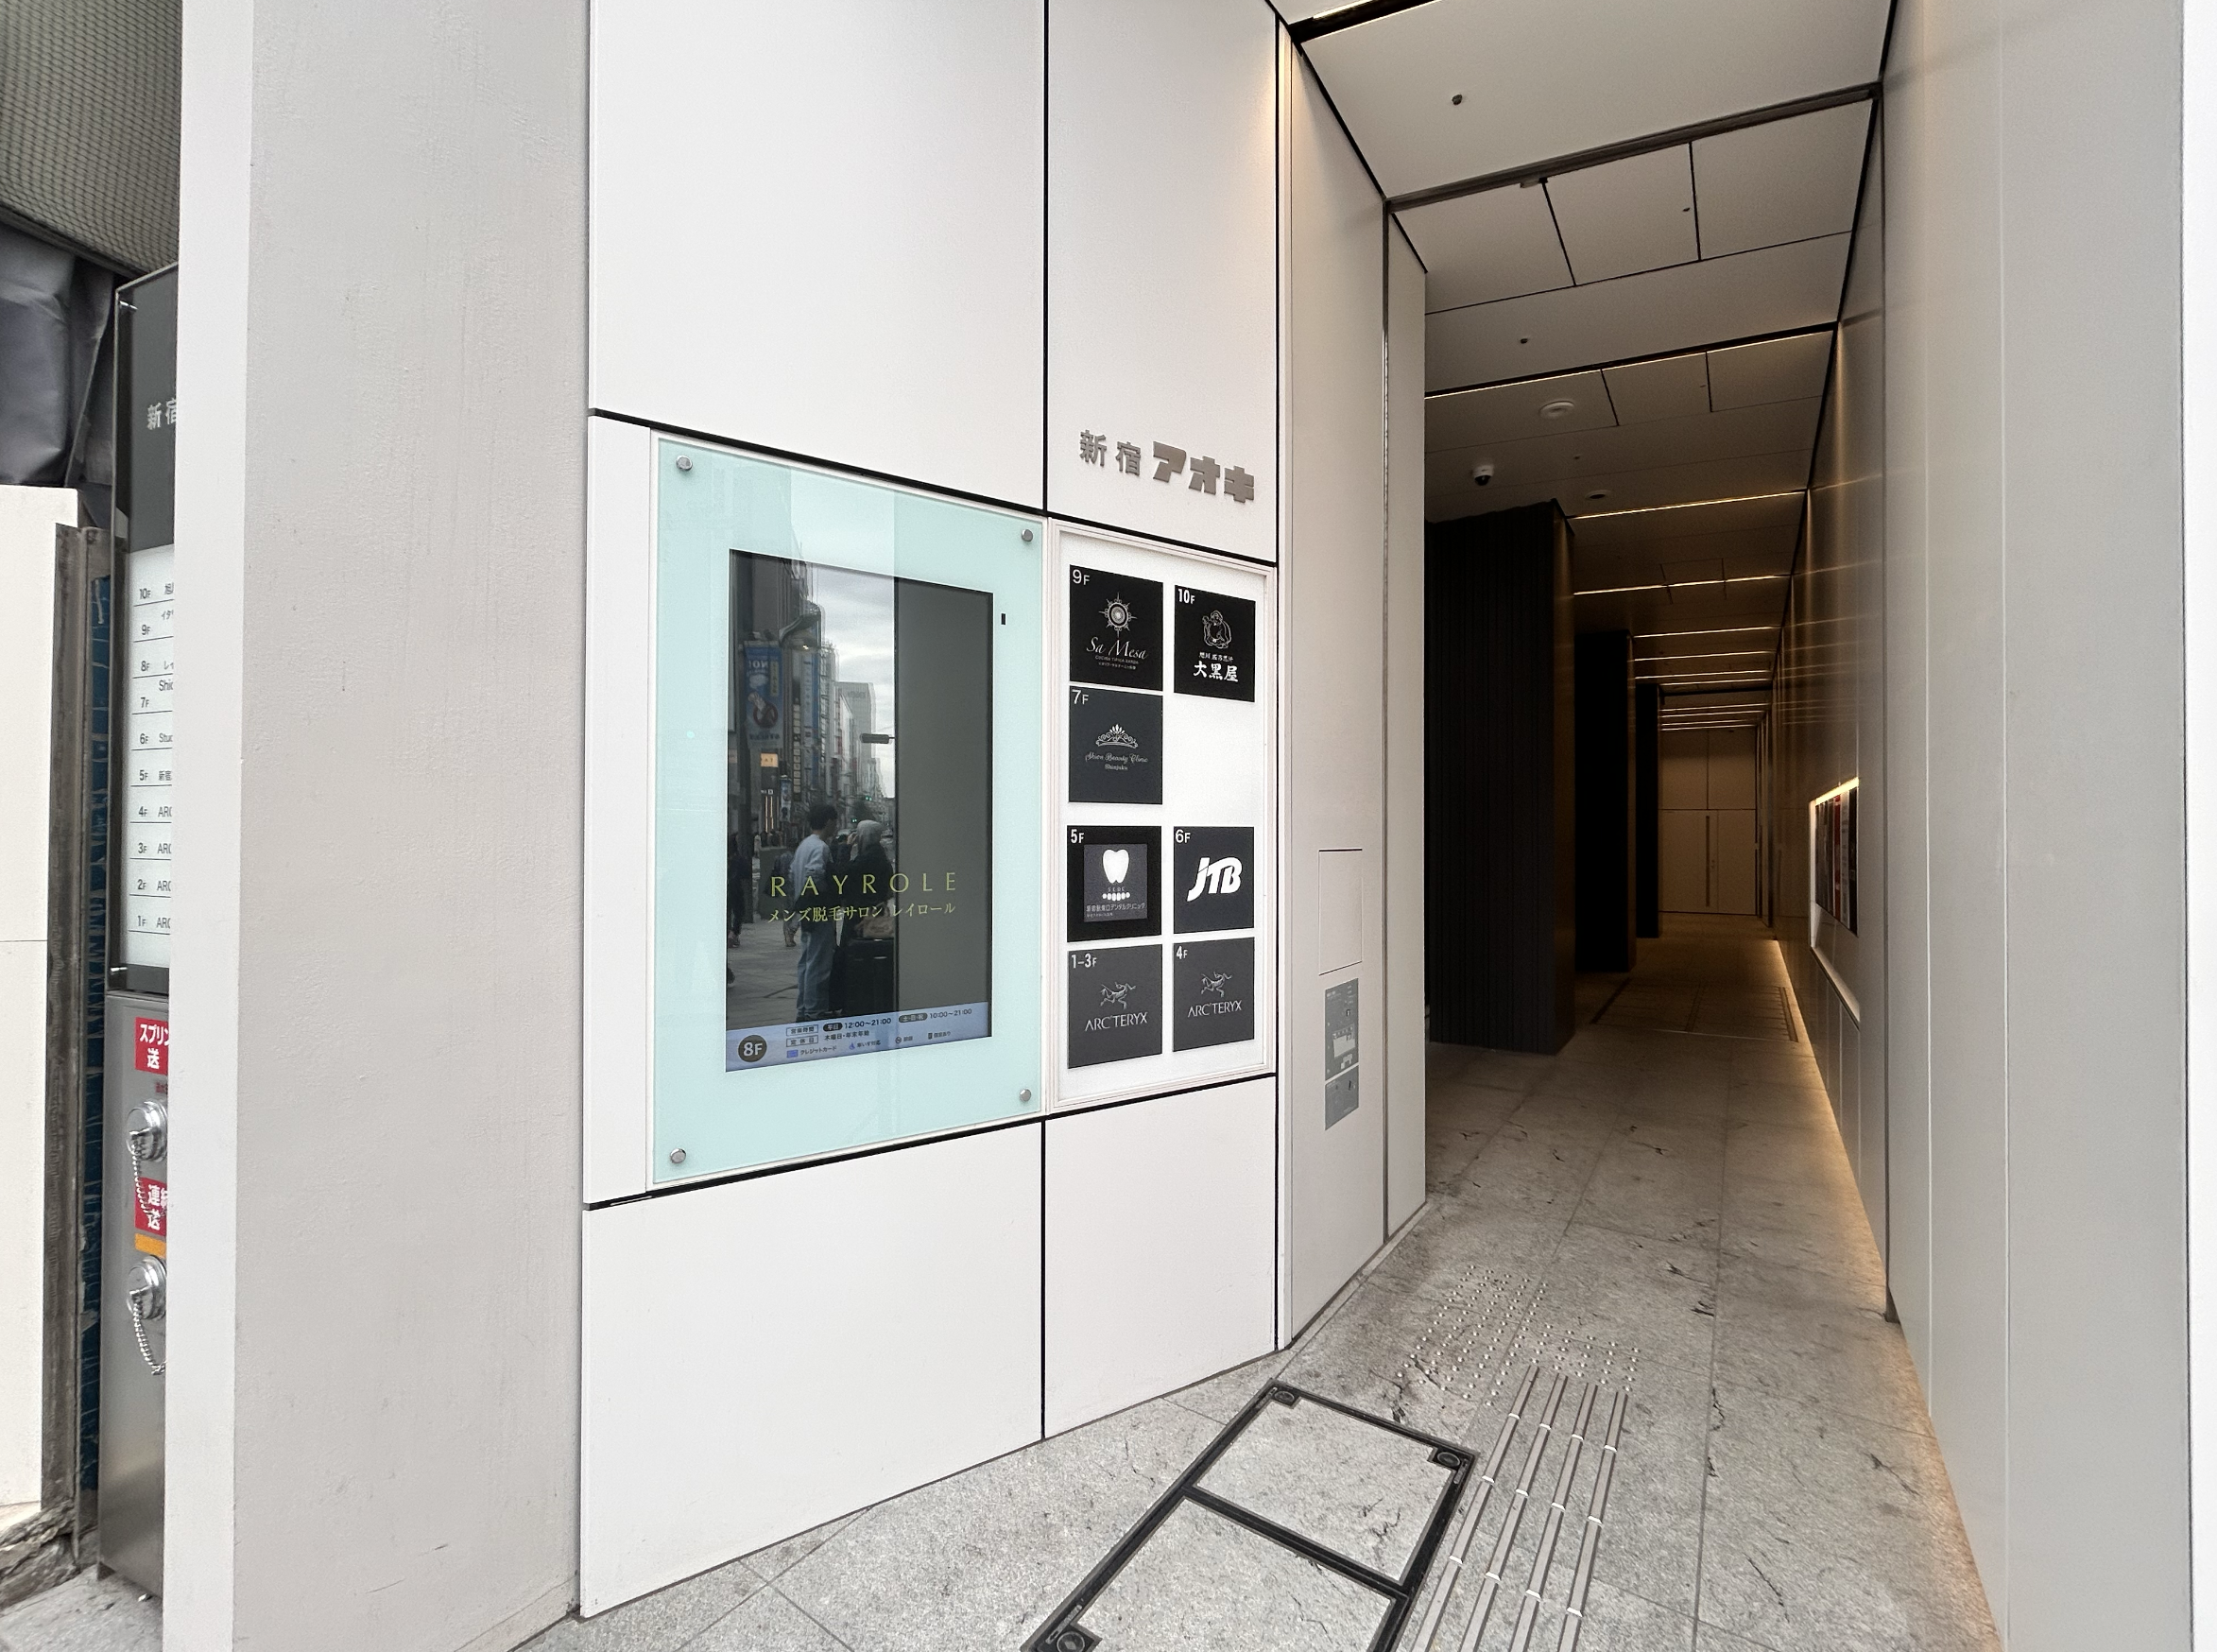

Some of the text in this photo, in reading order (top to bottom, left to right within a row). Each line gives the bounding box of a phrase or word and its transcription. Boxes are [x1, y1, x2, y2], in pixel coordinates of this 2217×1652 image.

[1072, 569, 1091, 586] 9F
[139, 588, 151, 599] 10F
[1177, 588, 1195, 605] 10F
[142, 624, 151, 635] 9F
[1086, 636, 1149, 660] Sa Mesa
[141, 660, 150, 671] 8F
[1193, 660, 1239, 682] 大黒屋
[140, 697, 150, 708] 7F
[1072, 689, 1089, 705] 7F
[139, 732, 149, 744] 6F
[139, 769, 148, 781] 5F
[138, 805, 147, 817] 4F
[1071, 829, 1085, 844] 5F
[1175, 829, 1191, 844] 6F
[137, 842, 147, 854] 3F
[137, 878, 146, 890] 2F
[770, 871, 956, 897] RAYROLE
[1187, 856, 1243, 903] JTB
[767, 902, 956, 923] メンズ脱毛サロン レイロール
[136, 915, 146, 927] 1F
[1176, 946, 1188, 960] 4F
[1071, 954, 1097, 969] 1-3F
[743, 1041, 763, 1057] 8F
[146, 1047, 160, 1070] 送
